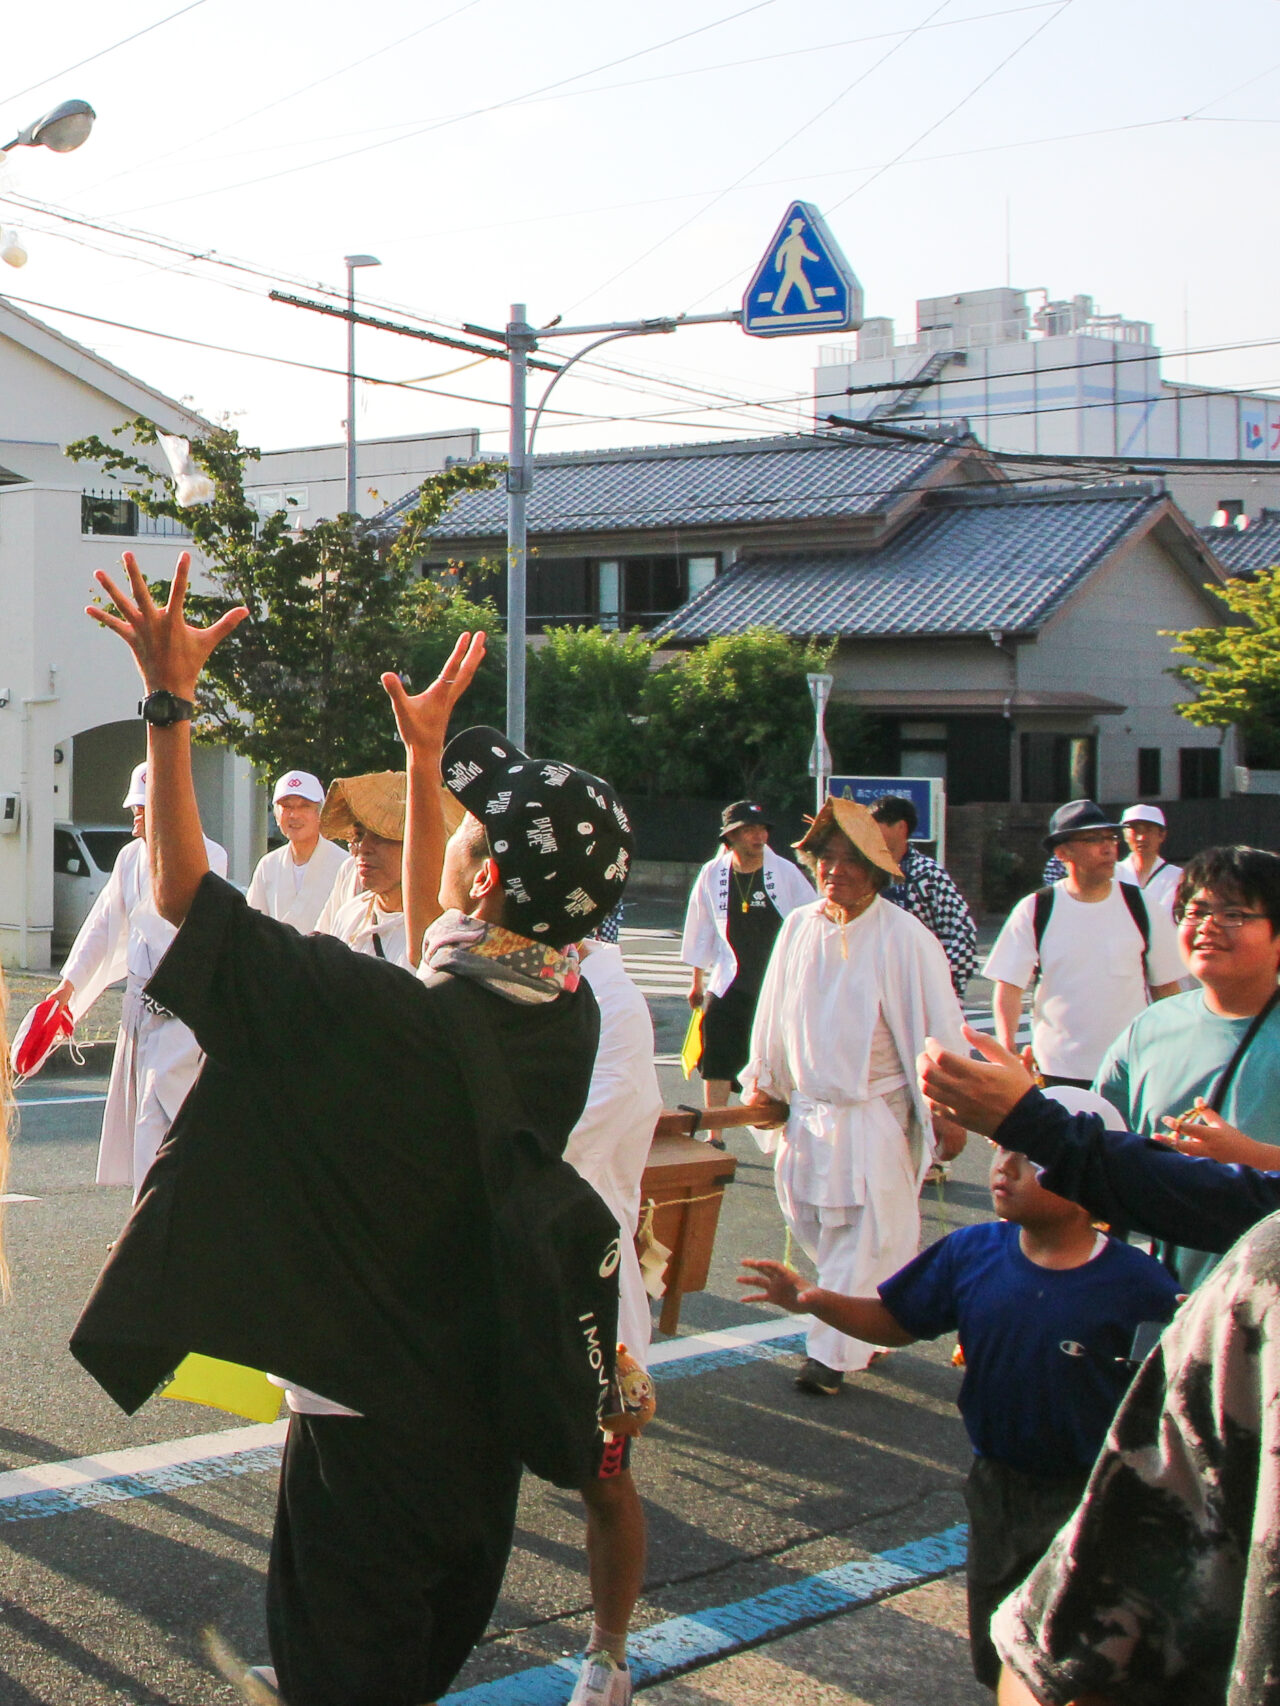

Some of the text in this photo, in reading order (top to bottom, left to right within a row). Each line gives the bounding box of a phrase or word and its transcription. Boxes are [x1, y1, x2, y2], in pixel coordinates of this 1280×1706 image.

[447, 761, 483, 792] BATHING
[448, 761, 466, 779] APE
[526, 829, 543, 847] APE
[532, 817, 558, 854] BATHING
